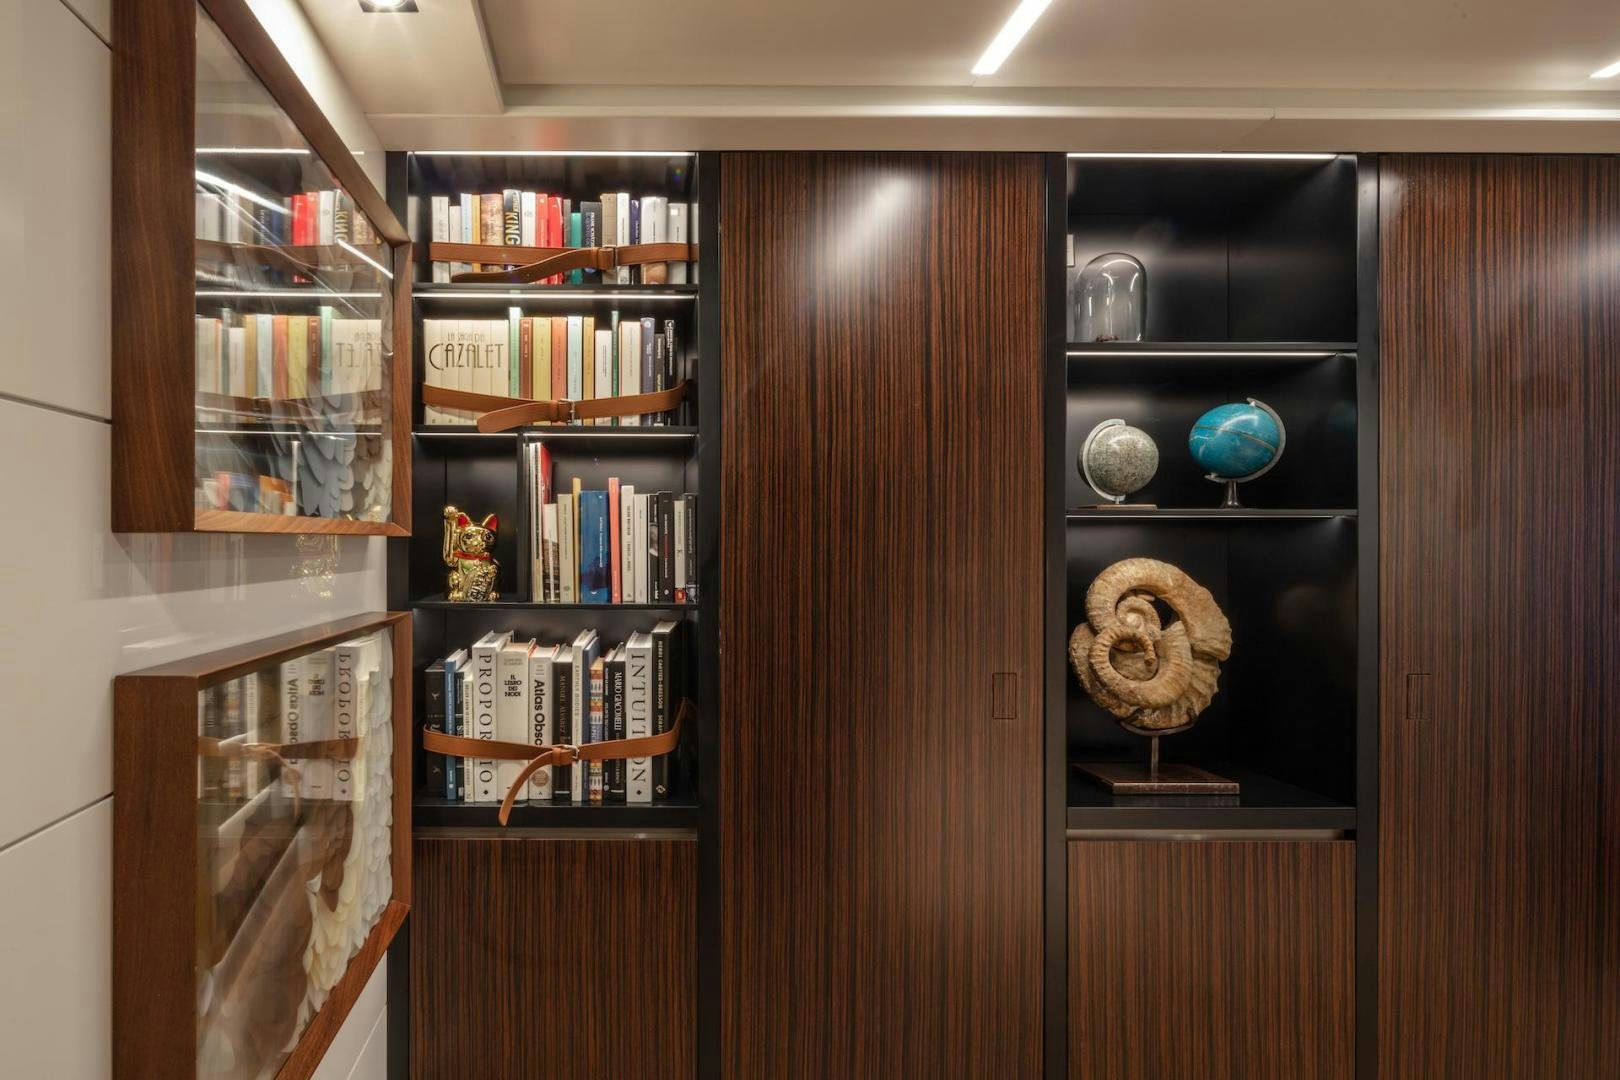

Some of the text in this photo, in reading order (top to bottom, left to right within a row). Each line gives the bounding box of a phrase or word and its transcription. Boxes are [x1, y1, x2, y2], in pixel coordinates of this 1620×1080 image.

[505, 212, 521, 245] KING
[429, 343, 504, 371] CAZALET
[479, 654, 493, 784] PROPORIO
[534, 679, 546, 746] Atlas Obsc
[614, 672, 622, 730] MARIO GIACOMELLI
[632, 654, 646, 783] INTUITON
